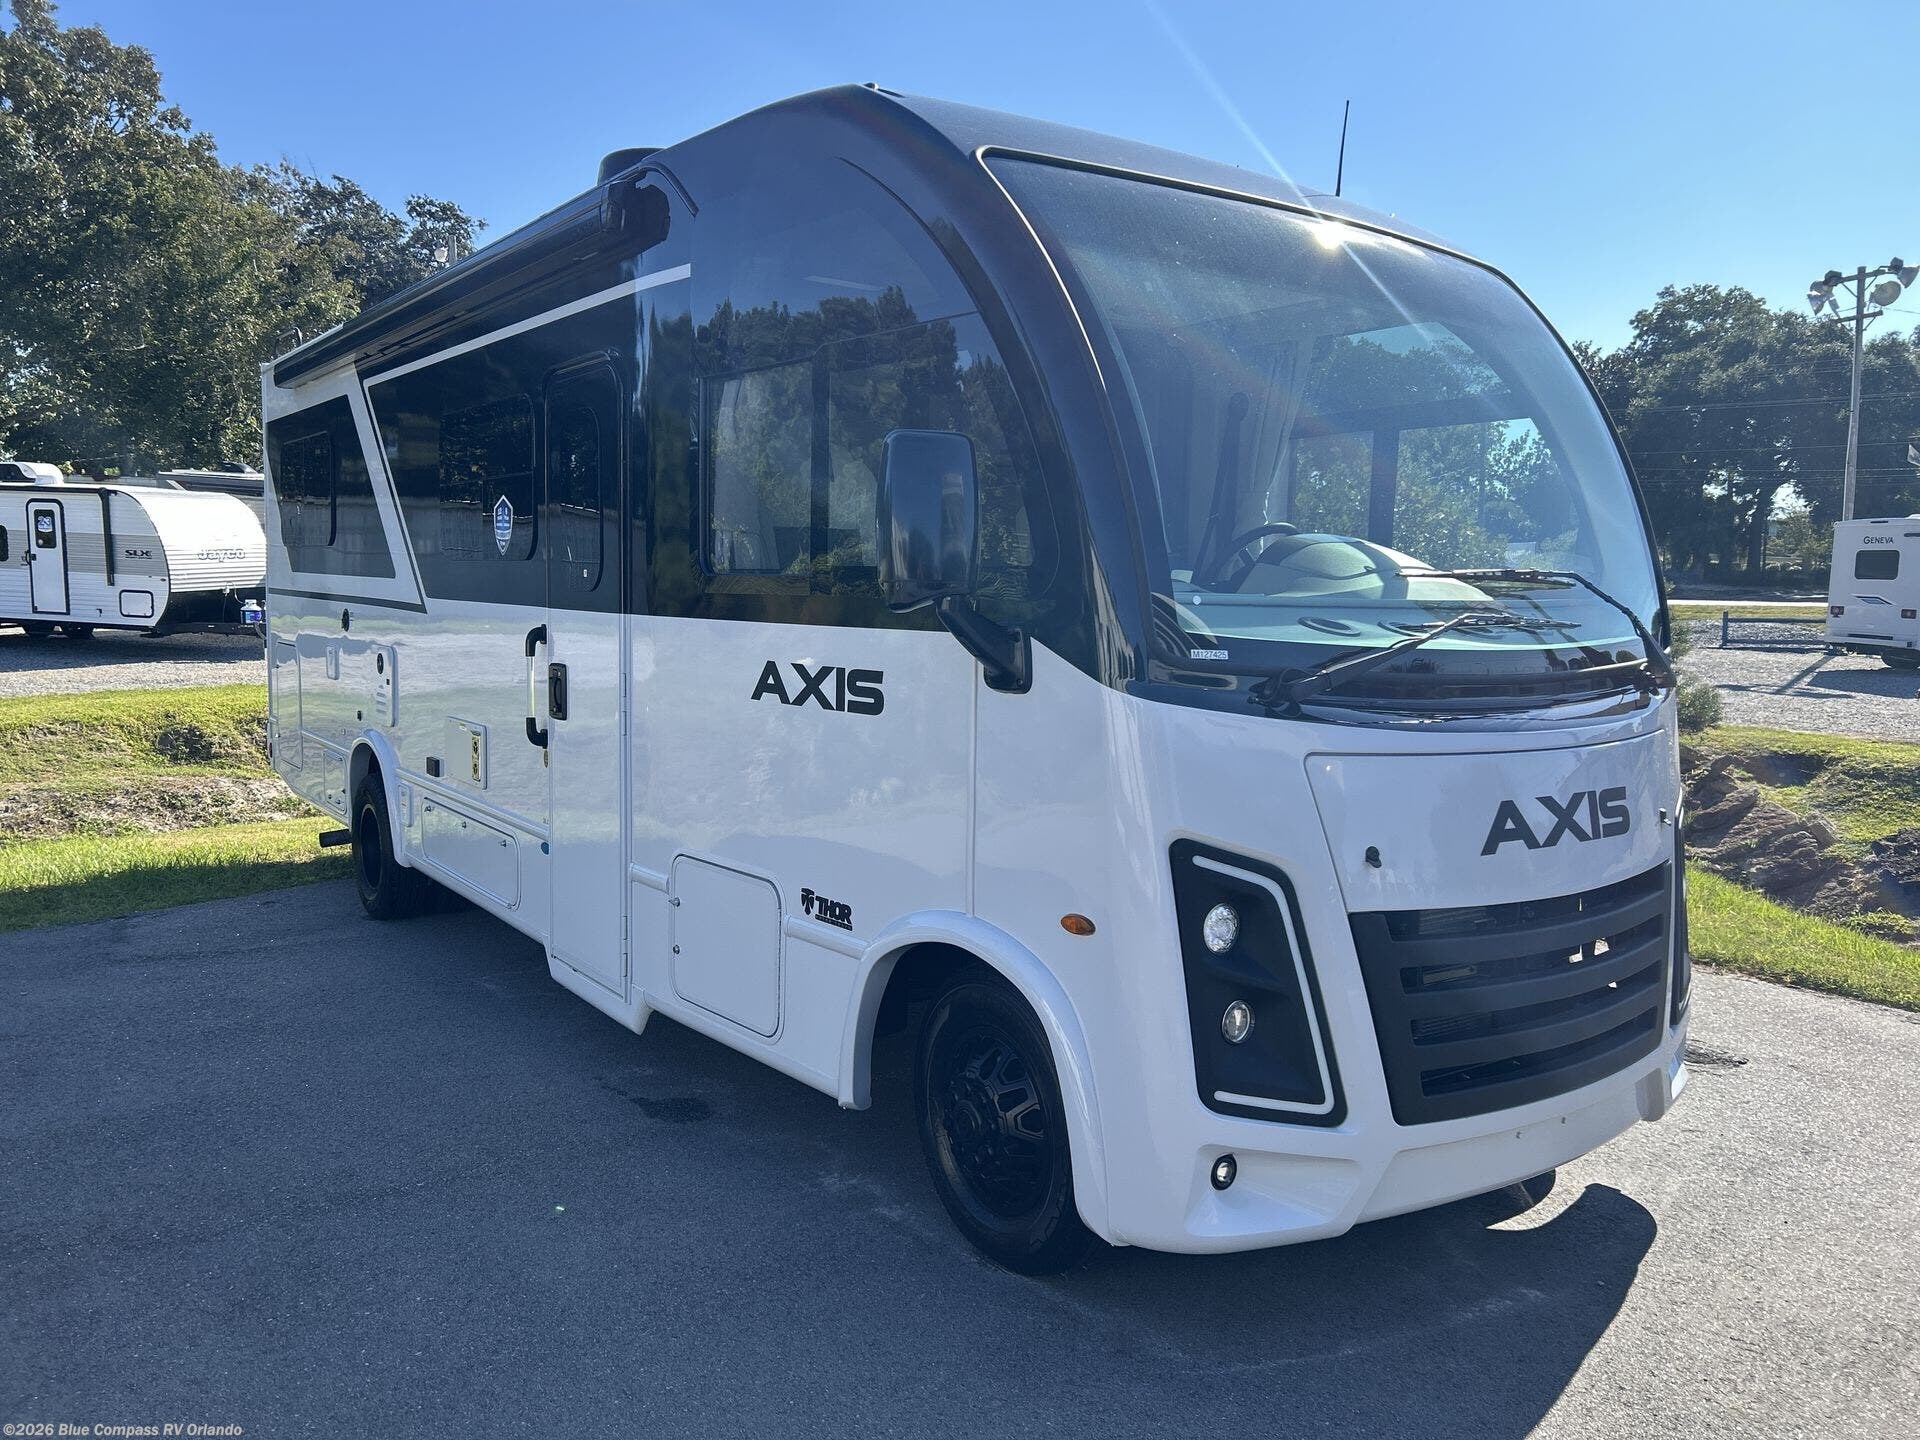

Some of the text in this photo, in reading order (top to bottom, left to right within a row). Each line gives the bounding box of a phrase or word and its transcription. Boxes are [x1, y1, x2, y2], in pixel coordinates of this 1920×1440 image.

[125, 549, 153, 557] SLX
[1863, 535, 1894, 545] GENEVA
[751, 660, 885, 716] AXIS
[1480, 786, 1631, 856] AXIS
[815, 895, 852, 925] THOR
